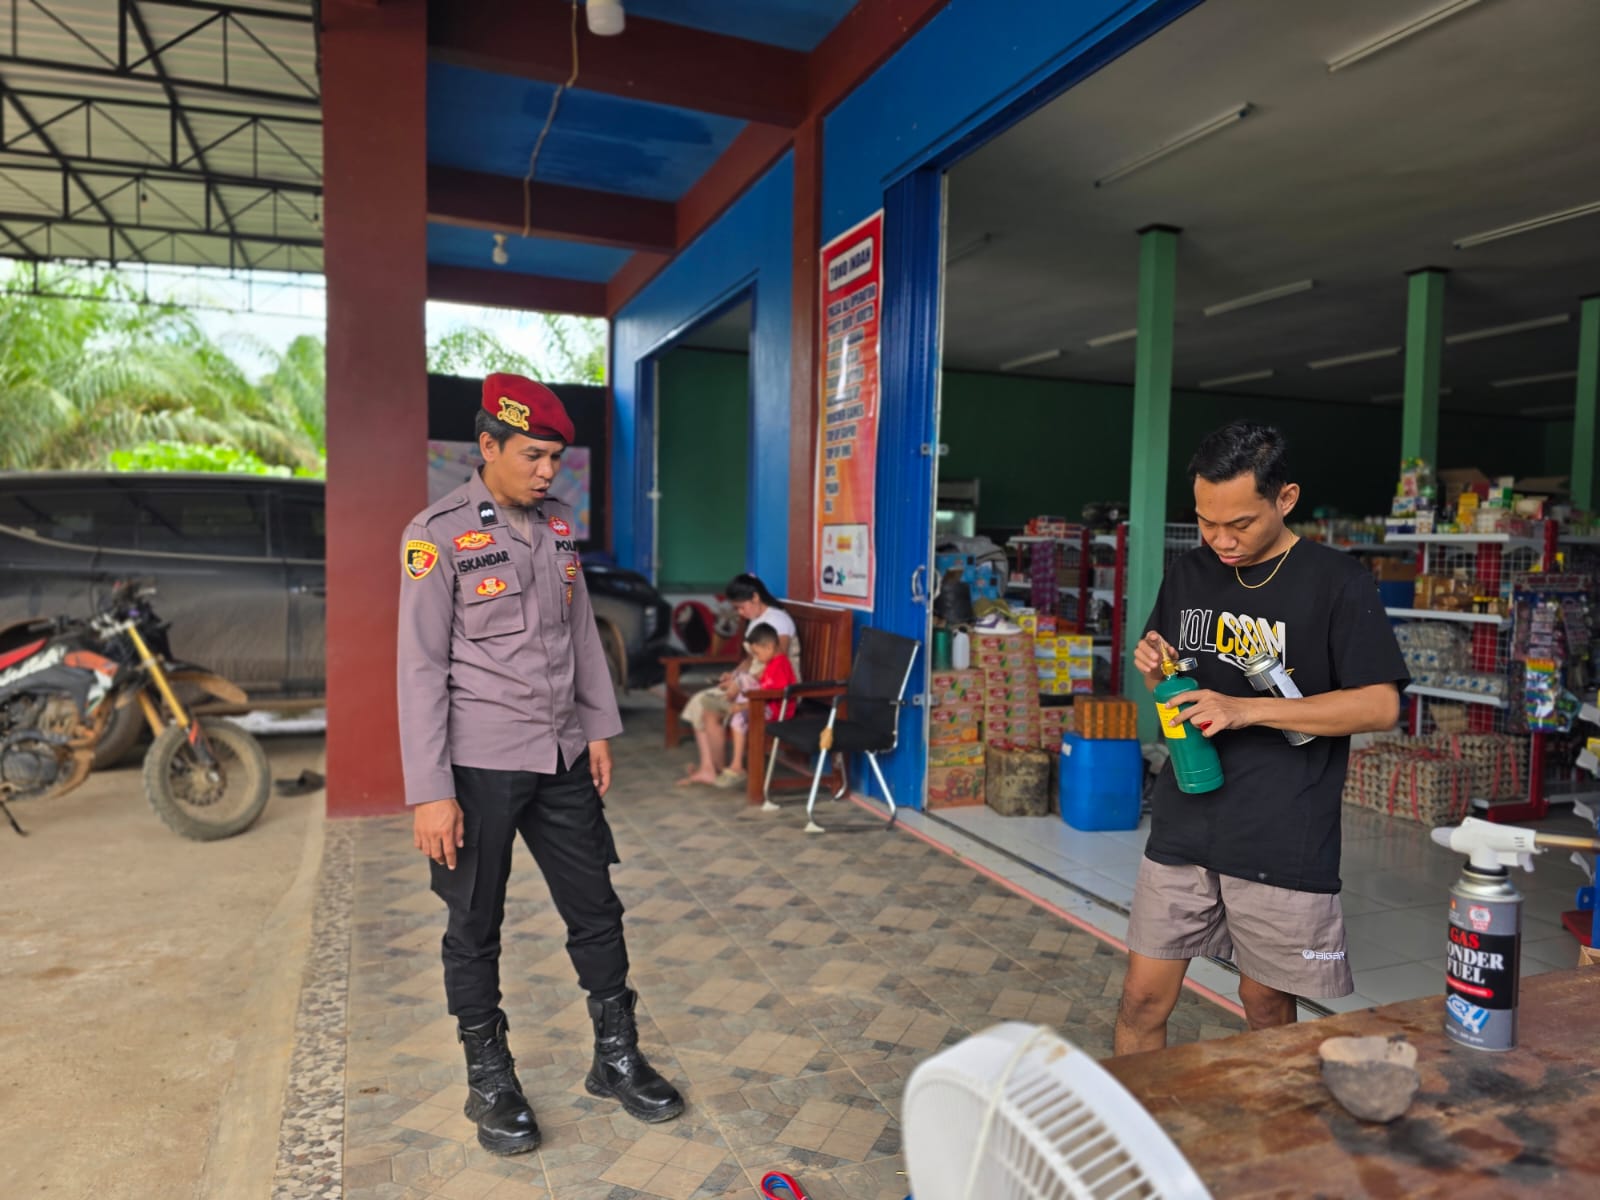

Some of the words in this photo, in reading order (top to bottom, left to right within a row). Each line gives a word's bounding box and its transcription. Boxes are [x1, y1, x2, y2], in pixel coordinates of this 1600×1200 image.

[829, 260, 848, 283] TOKO
[849, 246, 871, 272] NOAH
[458, 551, 510, 572] ISKANDAR
[1449, 927, 1480, 950] GAS
